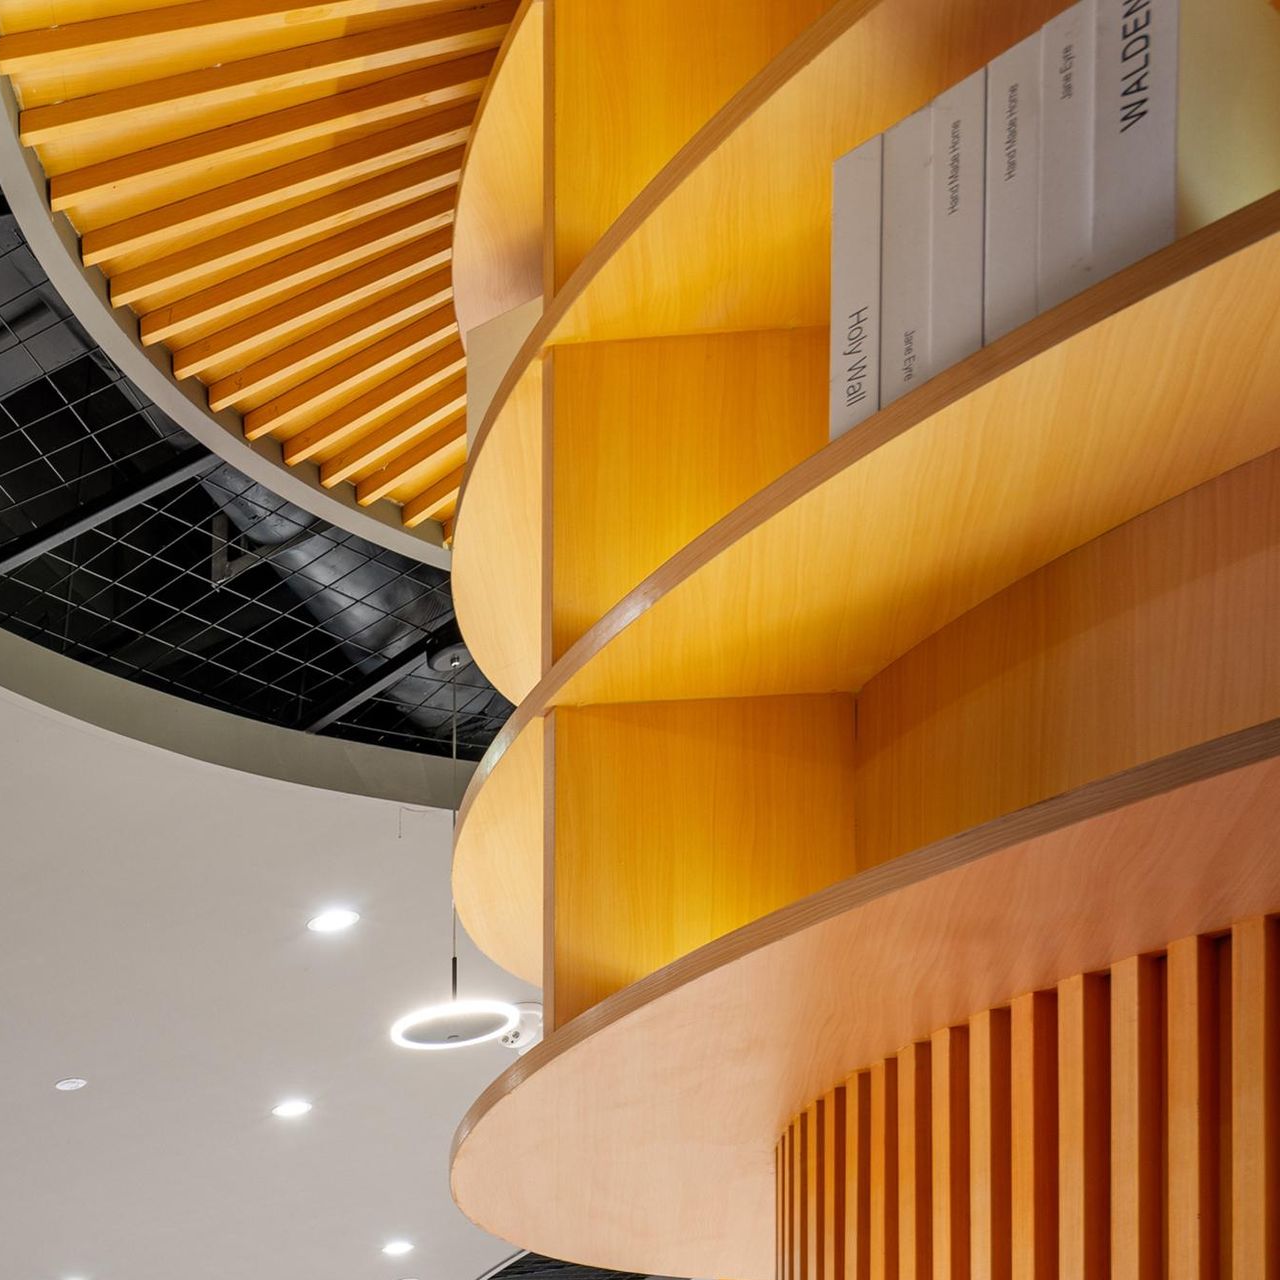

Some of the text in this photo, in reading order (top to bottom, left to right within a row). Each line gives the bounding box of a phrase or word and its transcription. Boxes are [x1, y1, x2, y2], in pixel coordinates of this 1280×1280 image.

[1059, 73, 1073, 100] Jane
[1120, 0, 1151, 133] WALDEN
[842, 306, 869, 407] Holy Wall
[903, 330, 916, 356] Jane
